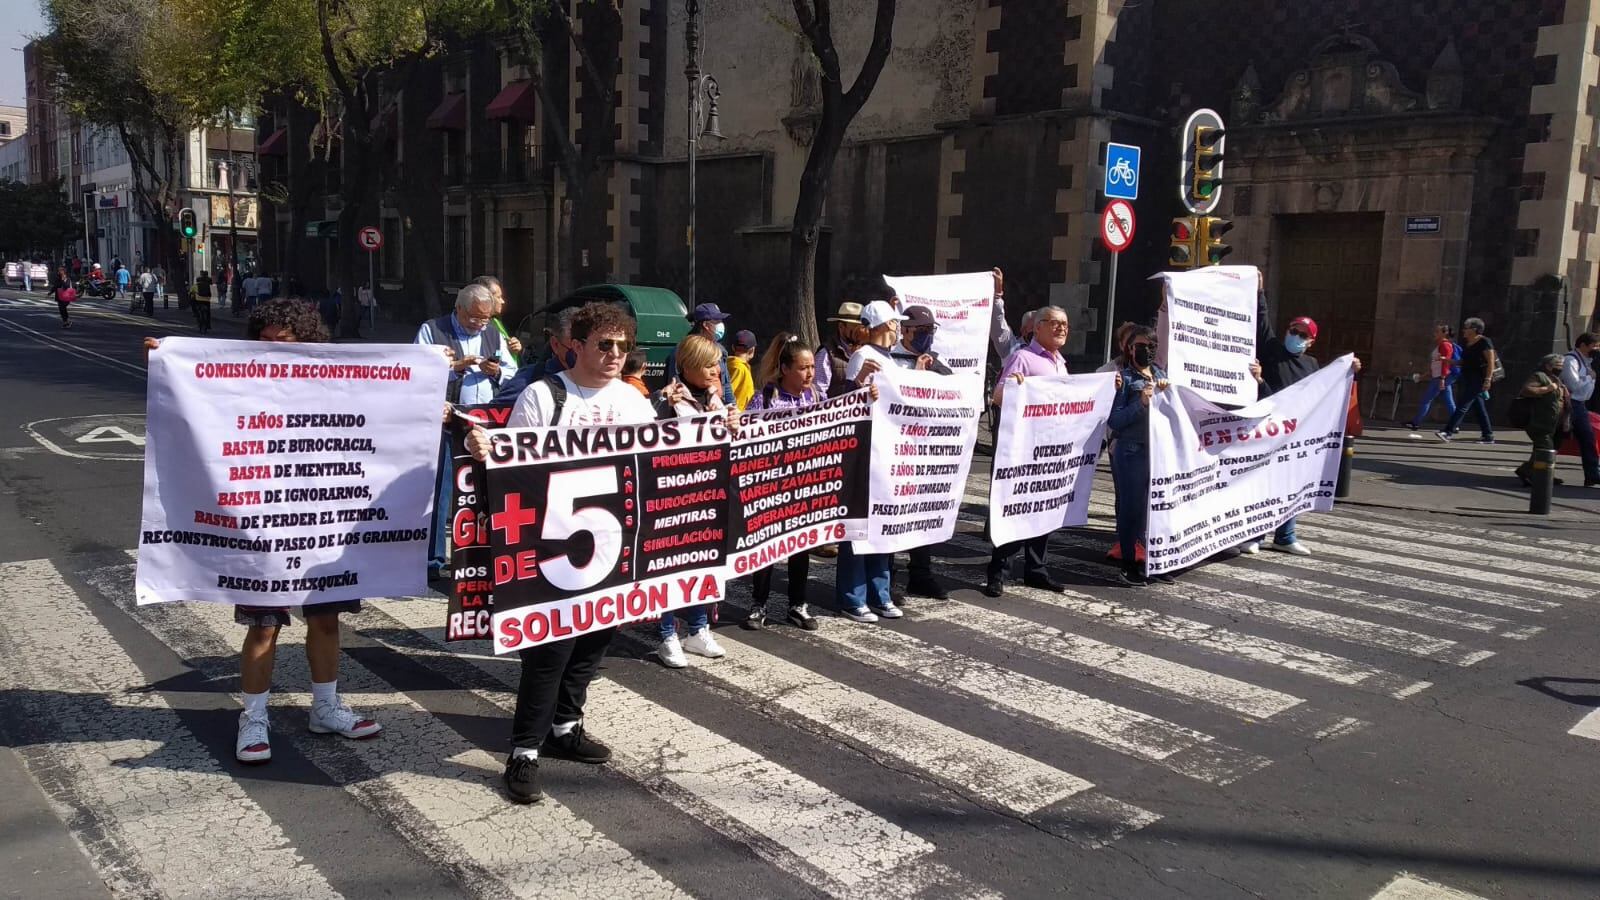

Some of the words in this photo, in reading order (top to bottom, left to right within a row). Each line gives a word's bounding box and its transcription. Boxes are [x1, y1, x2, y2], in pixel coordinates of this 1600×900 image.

[195, 360, 267, 379] COMISIÓN
[269, 364, 288, 378] DE
[291, 363, 411, 380] RECONSTRUCCIÓN
[763, 410, 793, 421] UNA
[888, 403, 902, 415] NO
[902, 405, 936, 418] TENEMOS
[1022, 403, 1058, 418] ATIENDE
[1059, 397, 1095, 415] COMISIÓN
[237, 416, 245, 430] 5
[248, 412, 283, 429] AÑOS
[286, 414, 366, 428] ESPERANDO
[751, 427, 765, 438] LA
[768, 406, 870, 434] RECONSTRUCCIÓN
[900, 424, 905, 435] 5
[906, 422, 927, 436] AÑOS
[927, 425, 961, 437] PERDIDOS
[222, 440, 264, 456] BASTA
[267, 439, 285, 453] DE
[288, 438, 376, 454] BUROCRACIA,
[490, 420, 681, 464] GRANADOS
[691, 415, 727, 443] 76
[730, 440, 783, 461] CLAUDIA
[787, 425, 856, 448] SHEINBAUM
[894, 444, 898, 455] 5
[899, 441, 917, 456] AÑOS
[918, 445, 927, 456] DE
[929, 445, 963, 456] MENTIRAS
[1290, 441, 1301, 449] LA
[1304, 432, 1342, 446] COMÓN
[652, 449, 722, 468] PROMESAS
[730, 455, 781, 476] ABNELY
[784, 437, 859, 463] MALDONADO
[1033, 442, 1073, 461] QUEREMOS
[1084, 453, 1096, 465] DE
[229, 465, 271, 481] BASTA
[273, 464, 292, 478] DE
[294, 462, 365, 478] MENTIRAS,
[657, 469, 717, 489] ENGAÑOS
[738, 465, 793, 488] ESTHELA
[796, 453, 842, 473] DAMIAN
[890, 465, 895, 476] 5
[896, 462, 914, 476] AÑOS
[915, 464, 925, 475] DE
[925, 464, 959, 475] PRETEXTOS
[1151, 490, 1165, 498] DE
[1278, 454, 1290, 463] DE
[1297, 451, 1307, 459] LA
[218, 490, 261, 506] BASTA
[264, 489, 281, 503] DE
[284, 485, 372, 502] IGNORARNOS,
[739, 482, 778, 503] KAREN
[781, 467, 843, 490] ZAVALETA
[894, 485, 899, 496] 5
[900, 482, 917, 496] AÑOS
[917, 482, 951, 495] IGNORADOS
[1013, 482, 1028, 495] LOS
[1030, 475, 1067, 494] GRANADOS
[646, 488, 727, 512] BUROCRACIA
[743, 492, 791, 518] ALFONSO
[794, 480, 842, 500] UBALDO
[872, 504, 899, 516] PASEO
[899, 504, 907, 515] DE
[907, 502, 919, 514] LOS
[919, 500, 950, 513] GRANADOS
[1002, 501, 1032, 517] PASEOS
[1033, 501, 1044, 513] DE
[194, 510, 238, 529] BASTA
[240, 515, 259, 529] DE
[262, 512, 317, 528] PERDER
[319, 510, 334, 525] EL
[337, 508, 388, 523] TIEMPO.
[654, 508, 717, 530] MENTIRAS
[747, 501, 808, 532] ESPERANZA
[811, 494, 838, 510] PITA
[1204, 531, 1212, 540] DE
[1214, 520, 1243, 536] NUESTRO
[1304, 491, 1332, 499] PASEO
[539, 465, 623, 592] 5
[736, 522, 782, 549] AGUSTIN
[785, 506, 848, 531] ESCUDERO
[881, 521, 905, 535] PASEOS
[905, 521, 913, 532] DE
[1149, 537, 1163, 545] NO
[1212, 515, 1221, 524] NO
[1225, 508, 1240, 519] MÁS
[142, 531, 272, 552] RECONSTRUCCIÓN
[274, 537, 315, 552] PASEO
[318, 535, 334, 549] DE
[337, 532, 359, 546] LOS
[362, 528, 427, 544] GRANADOS
[643, 527, 723, 552] SIMULACIÓN
[734, 529, 818, 574] GRANADOS
[824, 522, 846, 541] 76
[1164, 558, 1178, 568] LOS
[1219, 531, 1246, 547] COLONIA
[1247, 521, 1273, 535] PASEOS
[286, 557, 301, 569] 76
[494, 550, 537, 585] DE
[647, 549, 719, 572] ABANDONO
[218, 575, 268, 592] PASEOS
[271, 579, 289, 592] DE
[291, 572, 358, 591] TAXQUEÑA
[455, 566, 487, 580] NOS
[462, 595, 483, 607] LA
[499, 582, 668, 648] SOLUCIÓN
[677, 574, 720, 603] YA
